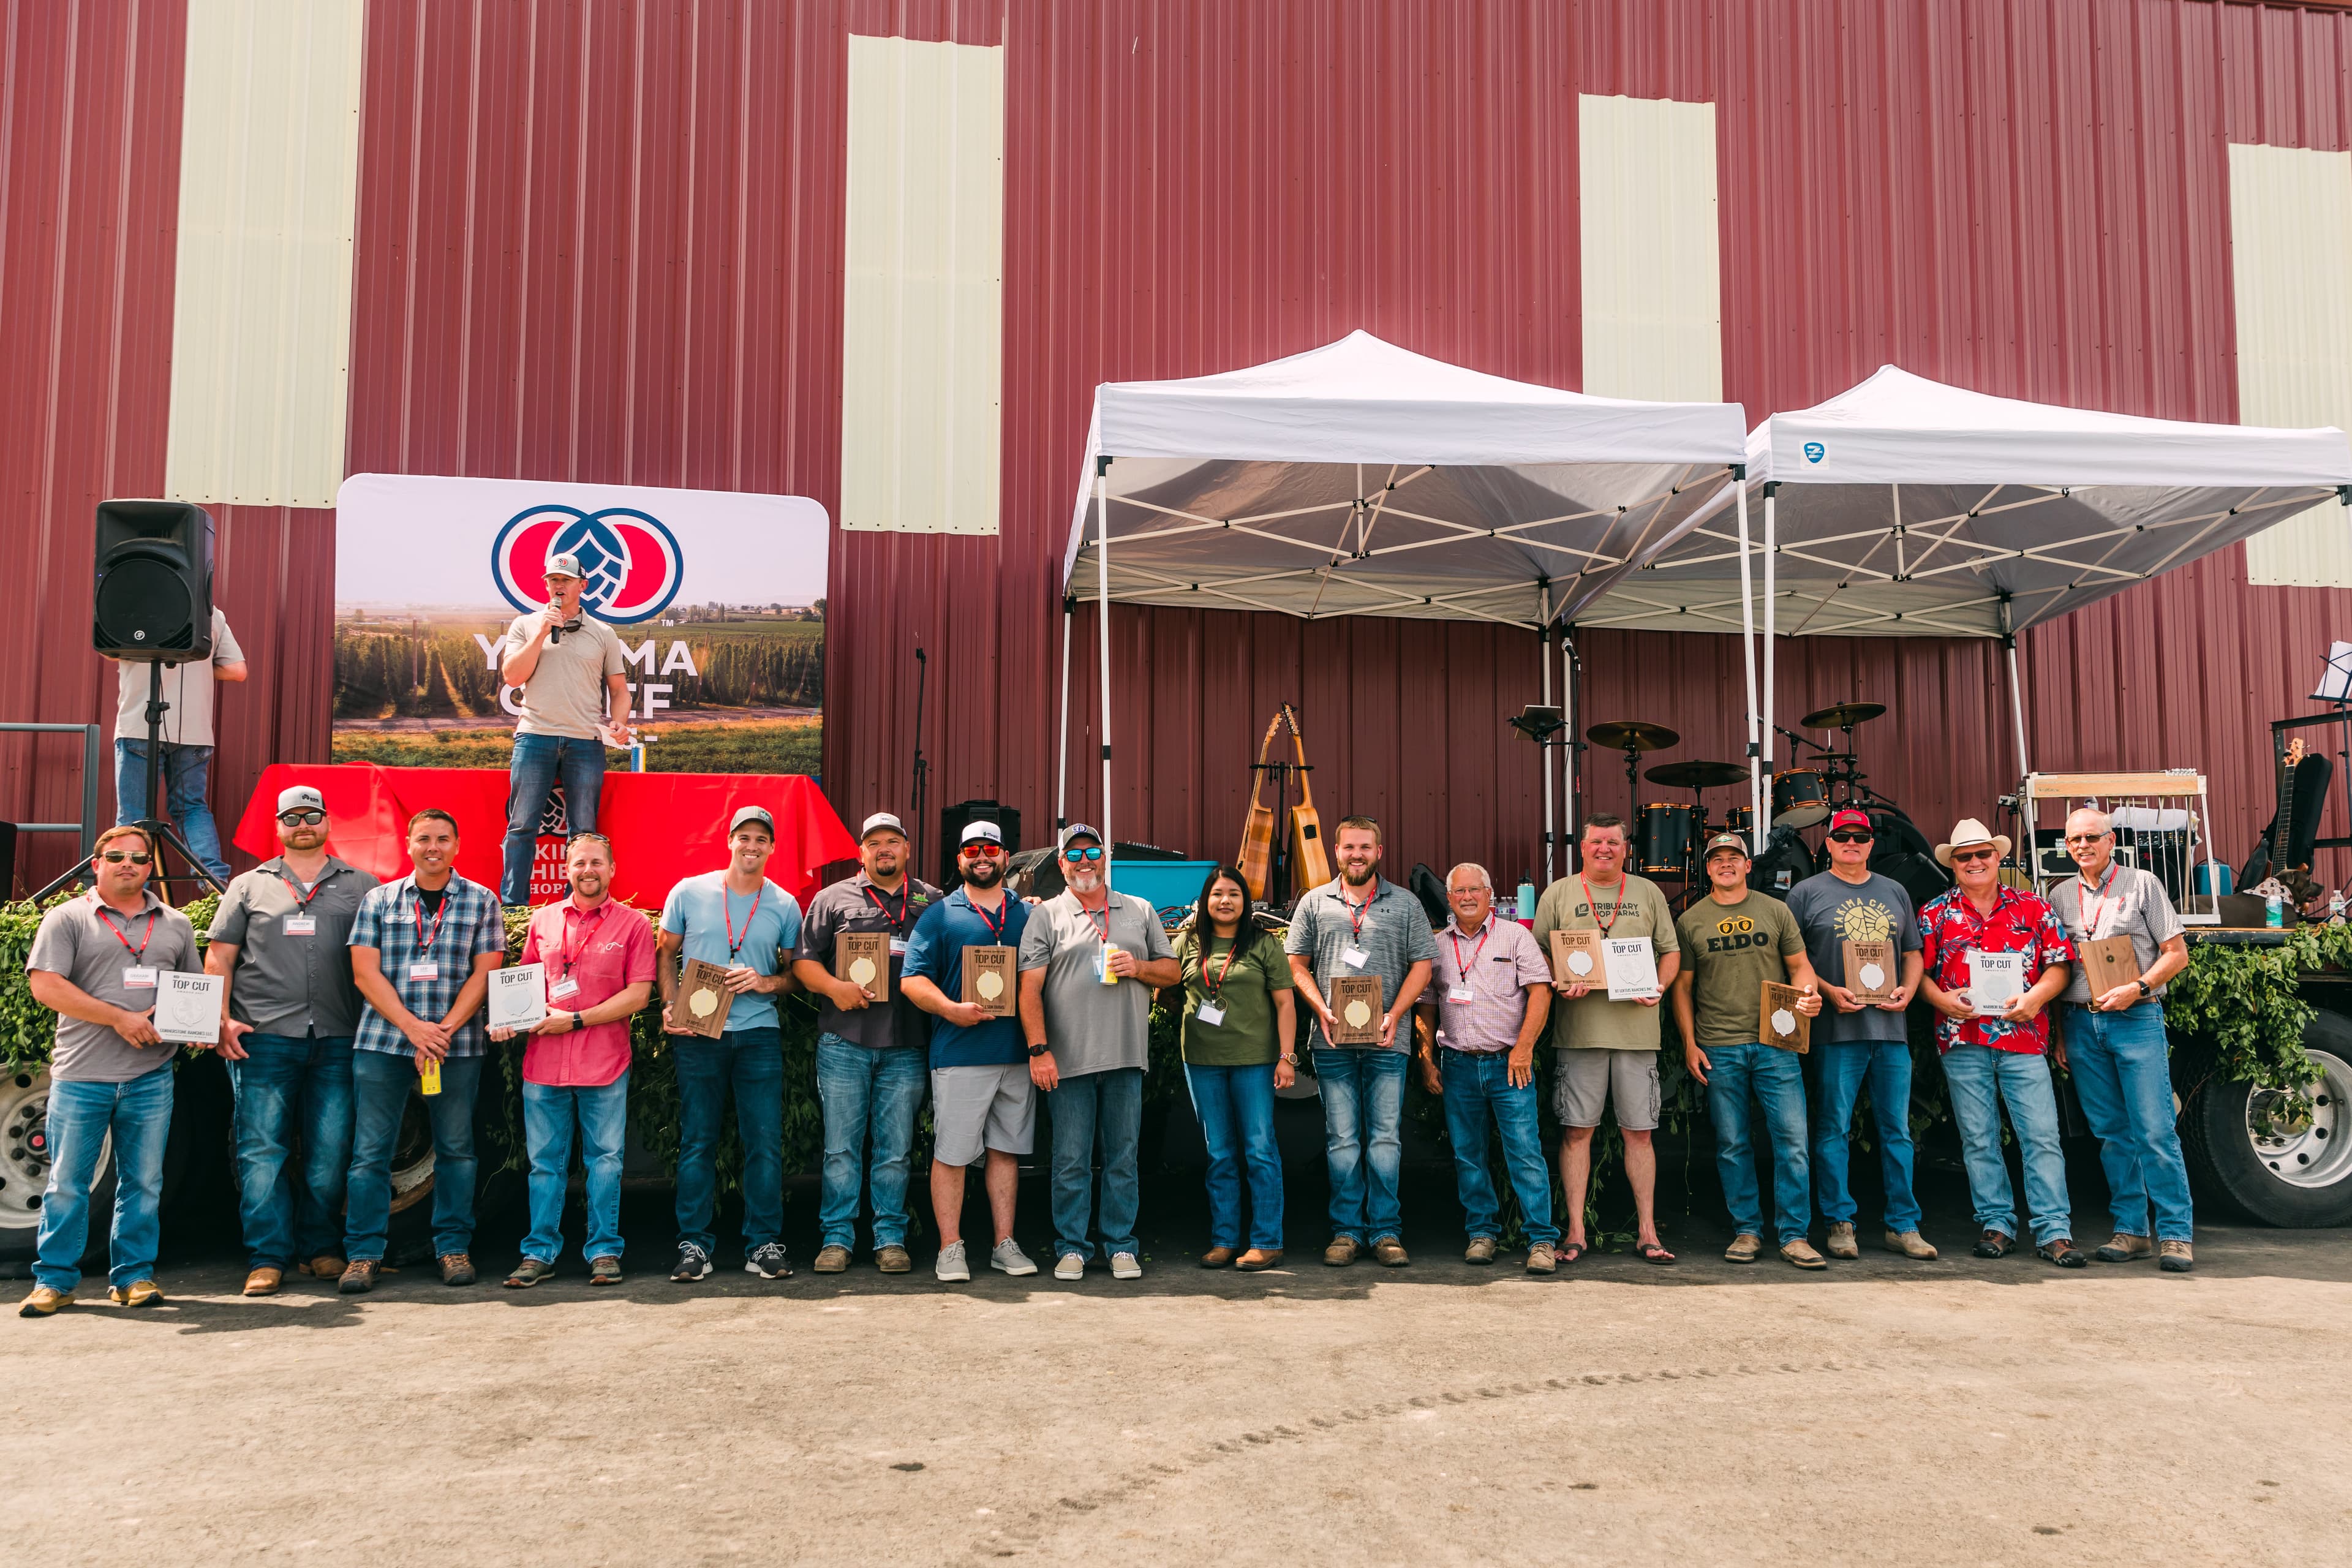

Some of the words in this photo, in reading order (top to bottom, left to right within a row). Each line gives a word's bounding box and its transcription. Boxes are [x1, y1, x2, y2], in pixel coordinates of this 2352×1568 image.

[473, 633, 698, 676] YMA
[500, 683, 673, 719] CEF
[530, 863, 568, 880] HIE
[1833, 897, 1864, 930] YAKIMA
[1869, 899, 1898, 927] CHIEF
[848, 941, 861, 950] TOP
[864, 941, 879, 950] CUT
[1706, 932, 1769, 952] ELDO
[1612, 945, 1626, 954] TOP
[1627, 944, 1642, 952] CUT
[1855, 948, 1868, 957] TOP
[1870, 949, 1884, 957] CUT
[974, 954, 989, 963] TOP
[990, 954, 1006, 963] CUT
[1980, 960, 1994, 968] TOP
[1997, 960, 2011, 968] CUT
[500, 974, 515, 984] TOP
[518, 971, 533, 982] CUT
[696, 969, 711, 981] TOP
[172, 979, 189, 989] TOP
[192, 981, 211, 991] CUT
[1341, 984, 1355, 993] TOP
[1357, 984, 1371, 993] CUT
[1771, 992, 1784, 1000] TOP
